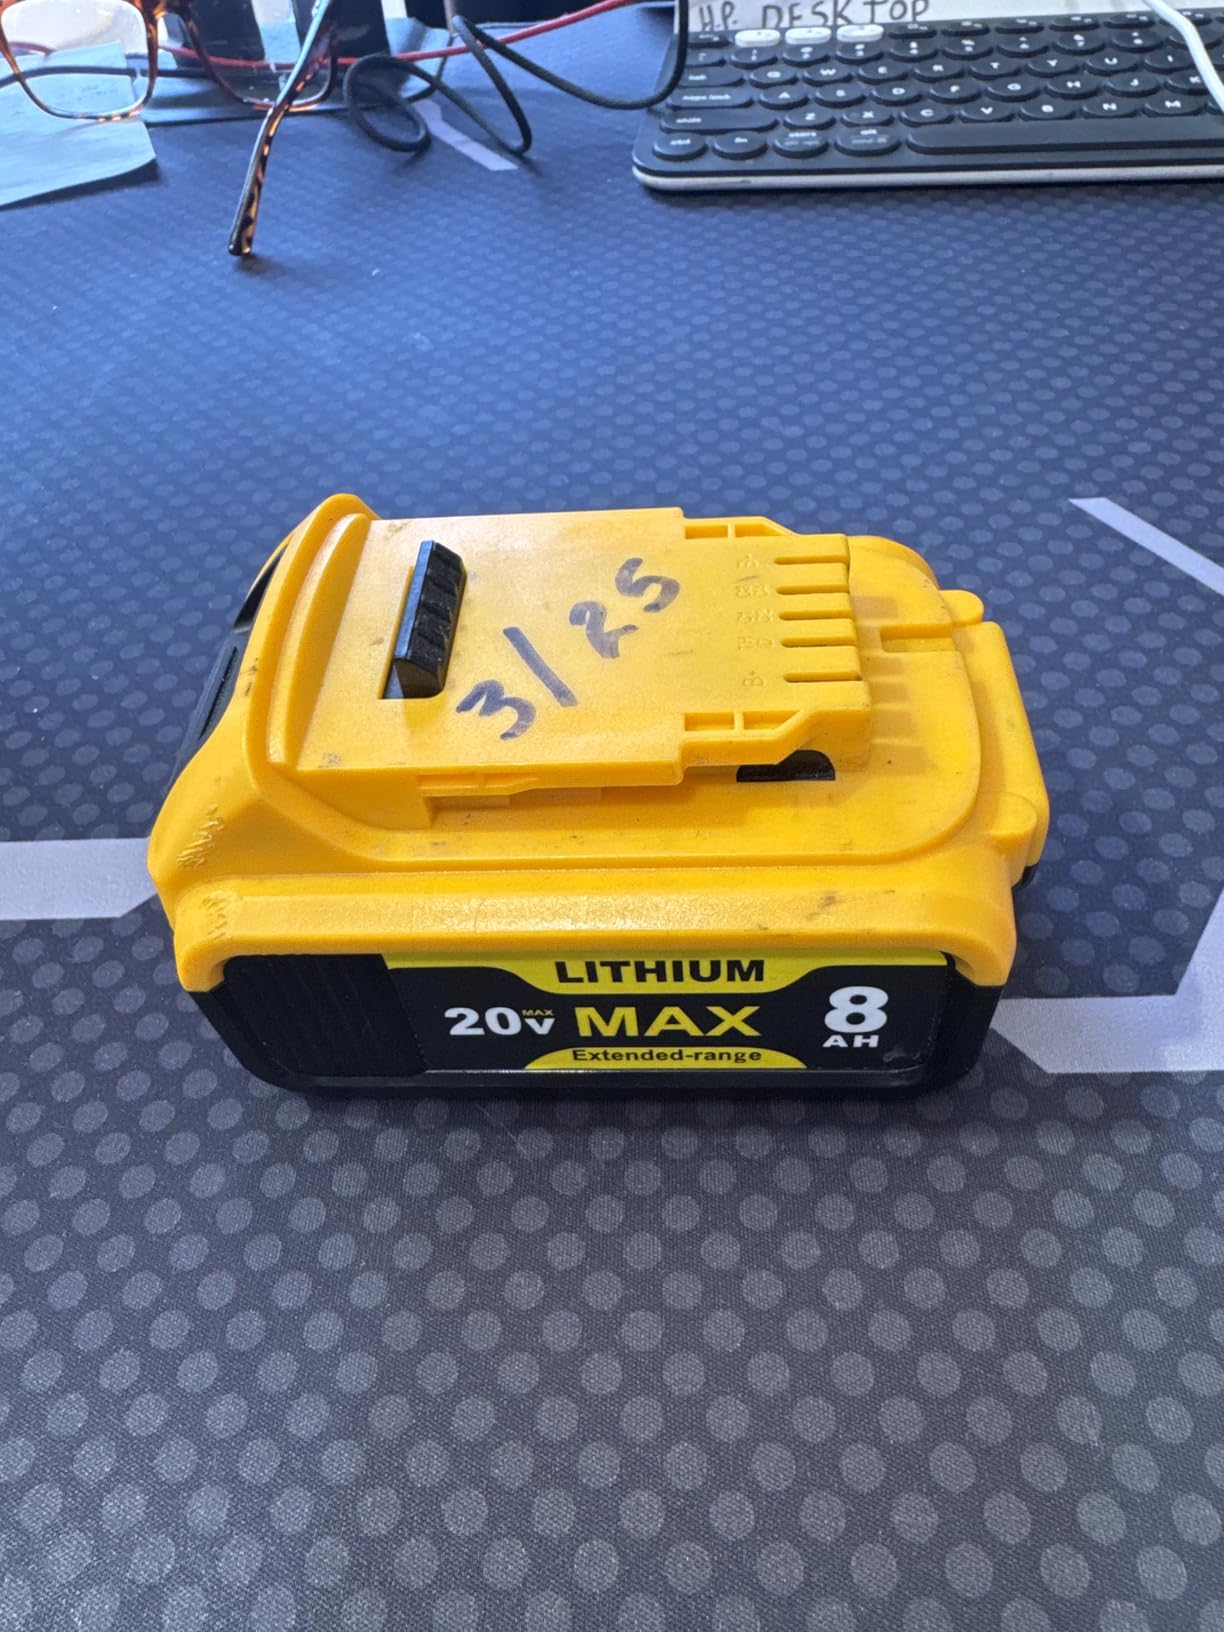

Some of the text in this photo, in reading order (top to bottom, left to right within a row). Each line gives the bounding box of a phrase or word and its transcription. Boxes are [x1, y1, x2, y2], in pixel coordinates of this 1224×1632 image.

[761, 0, 929, 28] DESKTOP
[456, 556, 680, 740] 3/25
[554, 959, 765, 984] LITHIUM
[521, 1009, 555, 1017] MAX
[574, 1005, 762, 1038] MAX
[824, 985, 889, 1033] 8
[822, 1034, 880, 1048] AH
[572, 1048, 762, 1063] Extended-range
